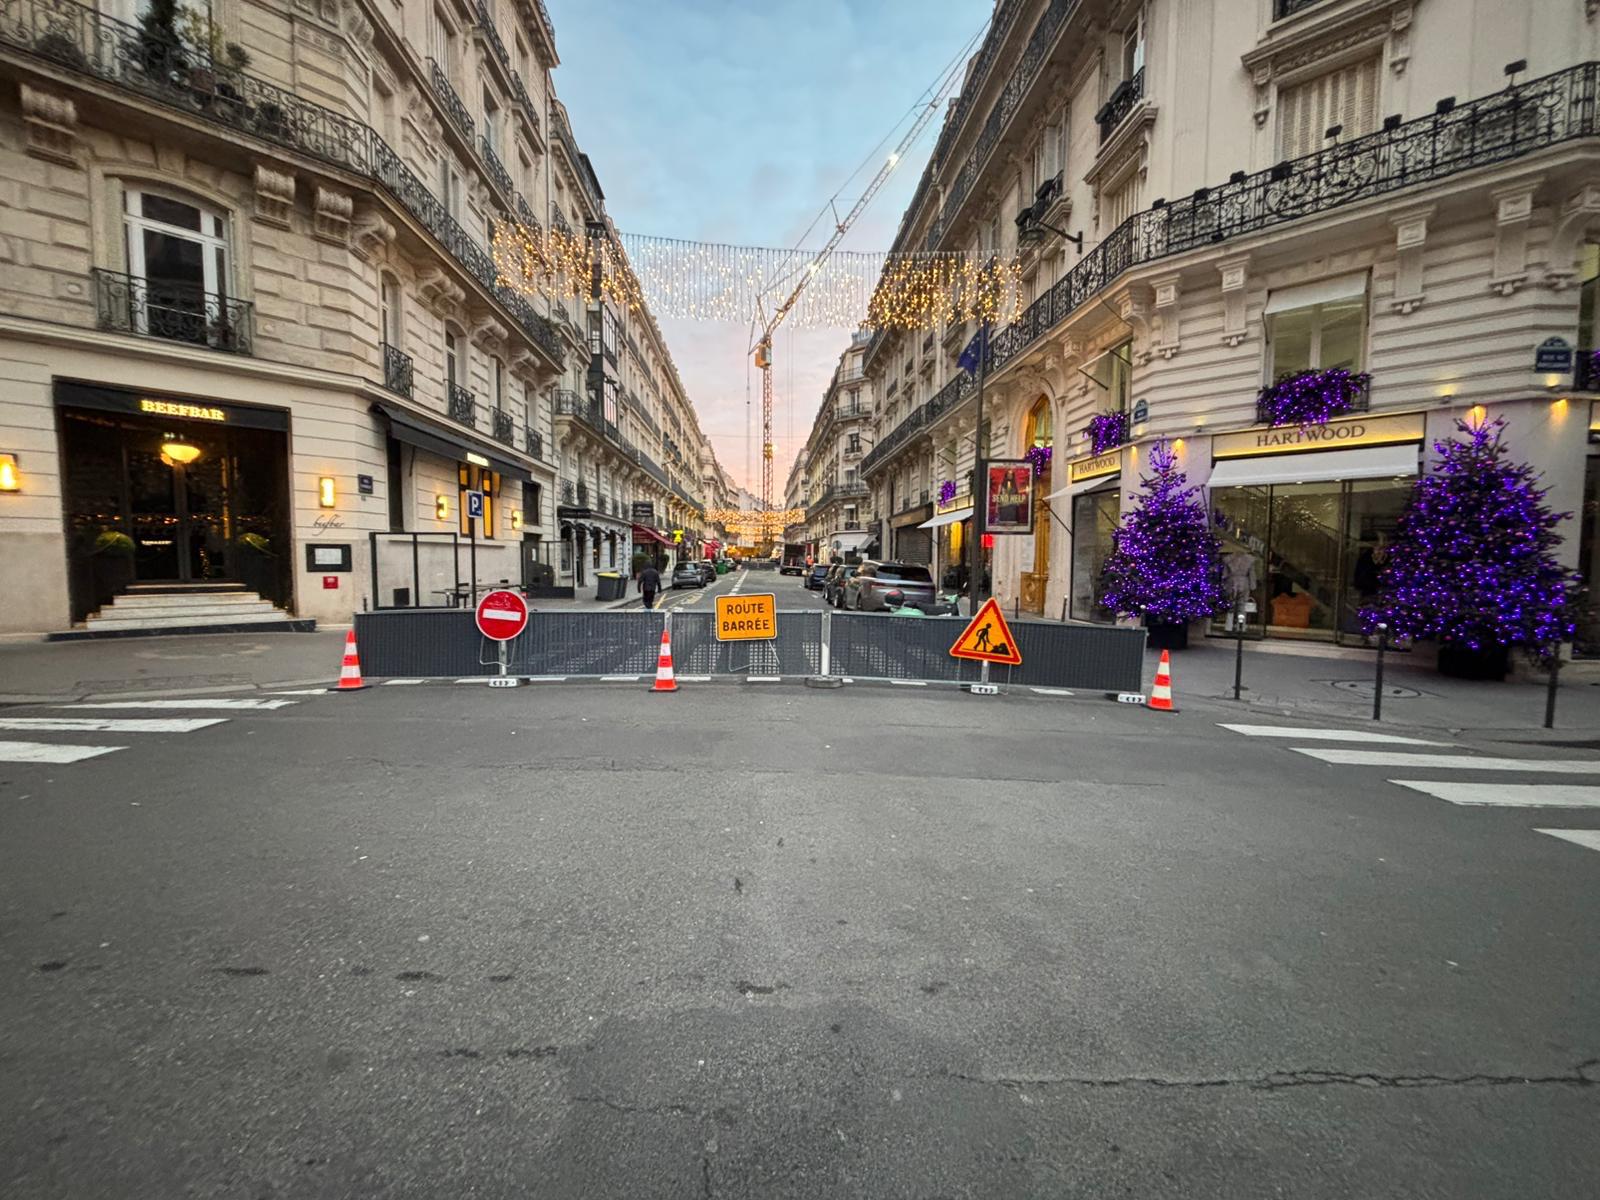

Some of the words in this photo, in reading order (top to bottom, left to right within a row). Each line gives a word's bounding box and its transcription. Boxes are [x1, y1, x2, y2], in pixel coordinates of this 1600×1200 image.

[140, 399, 225, 422] BEEFBAR
[1256, 424, 1366, 447] HARTWOOD
[1078, 456, 1116, 475] HARTWOOD
[471, 496, 479, 512] P
[991, 494, 1009, 503] SEND
[1009, 493, 1027, 503] HELP
[726, 602, 765, 615] ROUTE
[722, 618, 770, 632] BARRÉE
